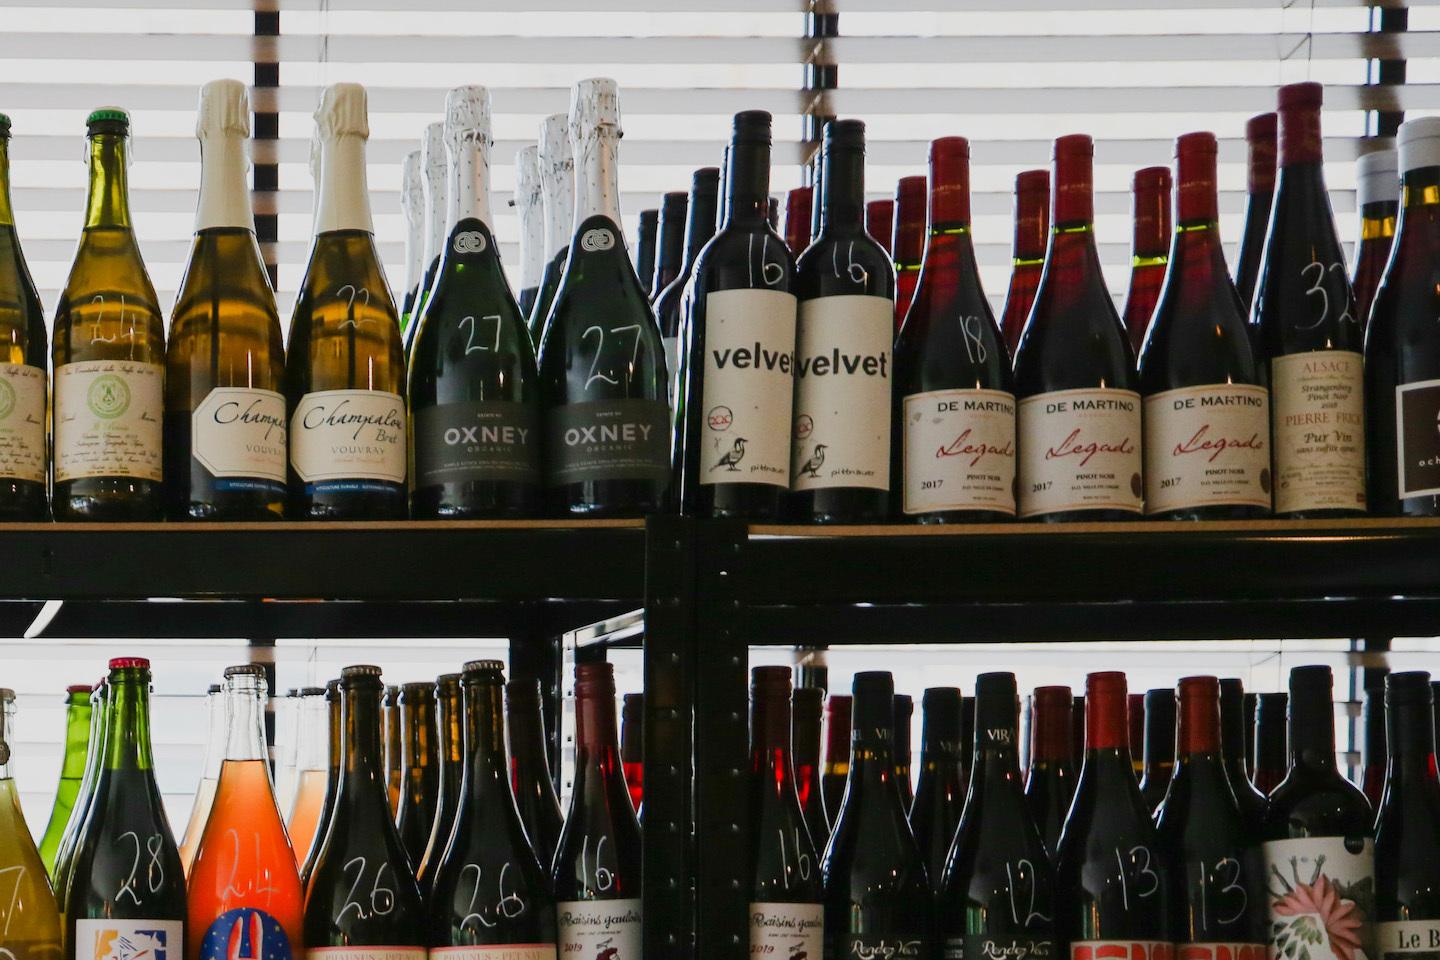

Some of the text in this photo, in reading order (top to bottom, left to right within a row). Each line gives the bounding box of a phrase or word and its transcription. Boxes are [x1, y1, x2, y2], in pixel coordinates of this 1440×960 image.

[748, 233, 785, 289] 16
[833, 240, 868, 285] 16
[1294, 261, 1358, 331] 32
[90, 295, 145, 360] 24
[458, 314, 504, 356] 27
[959, 315, 987, 364] 18
[581, 324, 644, 391] 27
[796, 348, 888, 378] velvet
[937, 401, 959, 412] DE
[1046, 400, 1134, 414] DE MARTINO
[1173, 395, 1263, 410] DE MARTINO
[1285, 412, 1330, 426] PIERRE
[330, 445, 387, 456] VOUVRAY
[444, 426, 529, 445] OXNEY
[564, 424, 653, 446] OXNEY
[1045, 428, 1135, 467] Legado
[1173, 424, 1264, 463] Legado
[921, 480, 944, 490] 2017
[966, 473, 985, 481] PINOT
[1032, 482, 1053, 492] 2017
[1076, 473, 1097, 481] PINOT
[1160, 477, 1182, 489] 2017
[1205, 468, 1227, 476] PINOT
[114, 831, 166, 905] 28
[220, 829, 281, 908] 24
[582, 834, 615, 893] 16
[778, 827, 811, 889] 16
[334, 856, 395, 926] 26
[459, 862, 526, 931] 26
[1005, 859, 1056, 928] 12
[1115, 845, 1159, 911] 13
[1199, 857, 1248, 932] 13
[564, 943, 583, 953] 2019
[750, 944, 775, 953] 2019
[1398, 930, 1421, 949] Le
